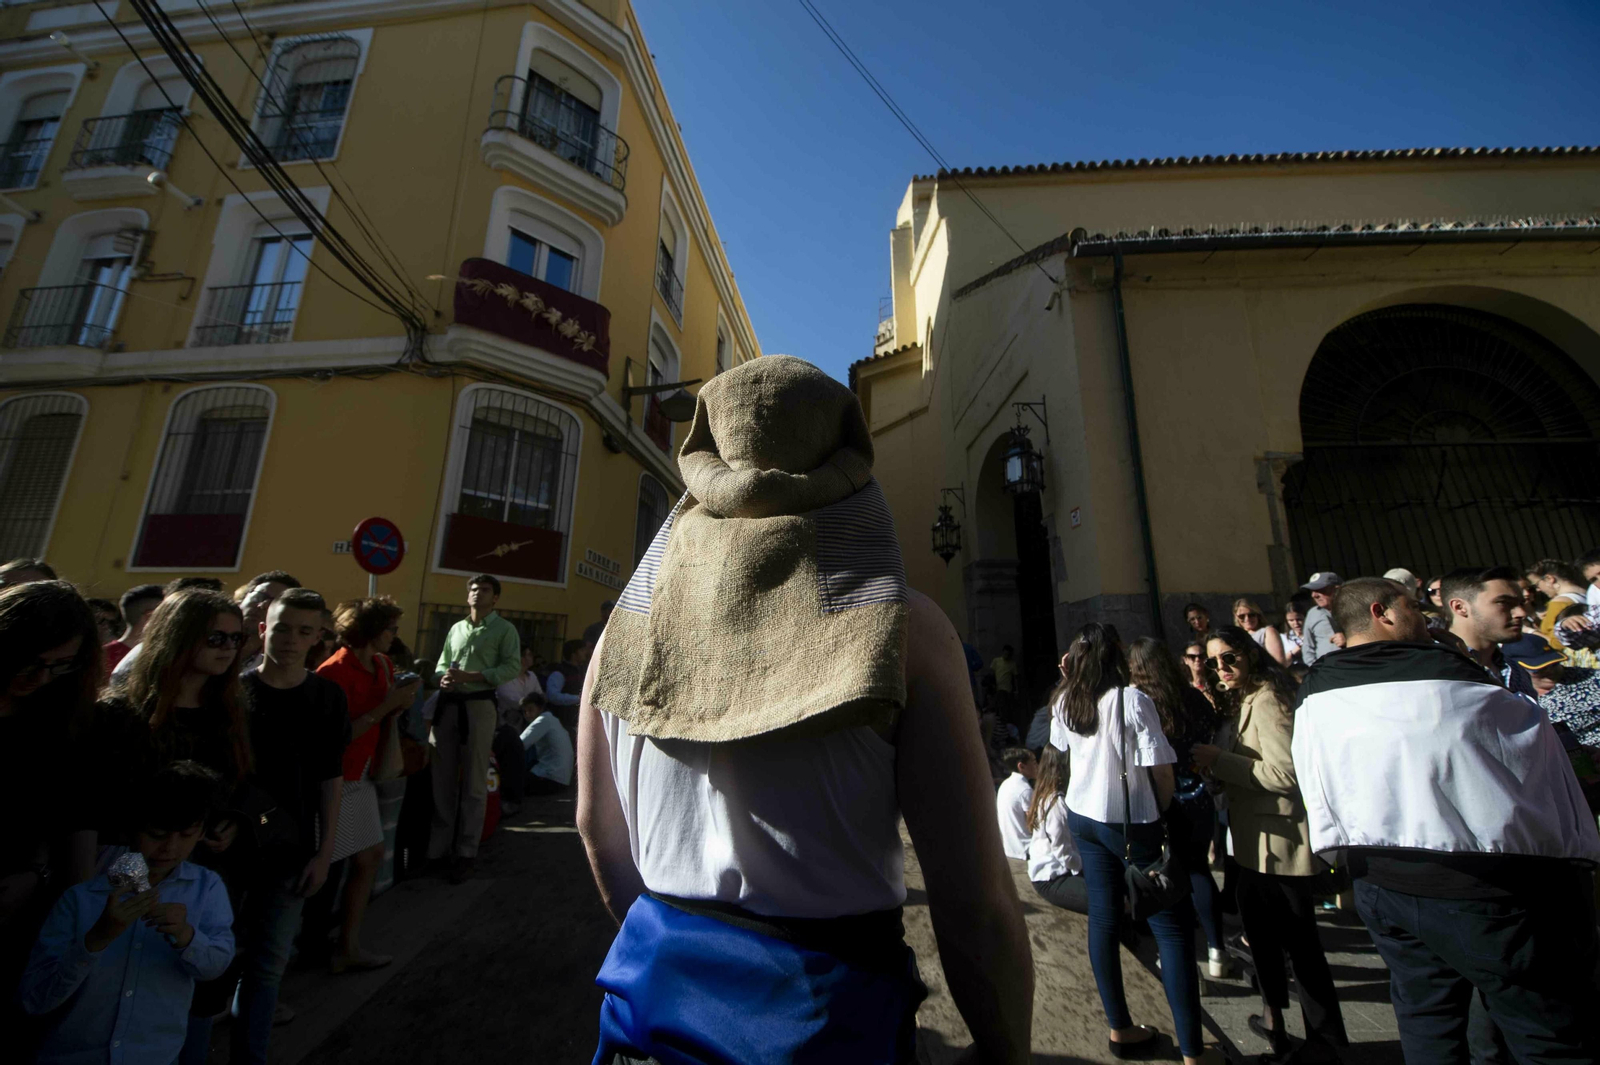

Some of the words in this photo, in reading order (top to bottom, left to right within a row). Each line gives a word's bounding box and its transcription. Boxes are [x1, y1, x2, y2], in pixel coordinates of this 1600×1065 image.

[578, 562, 593, 578] SAN
[587, 549, 610, 569] TORRE
[612, 561, 620, 574] DE
